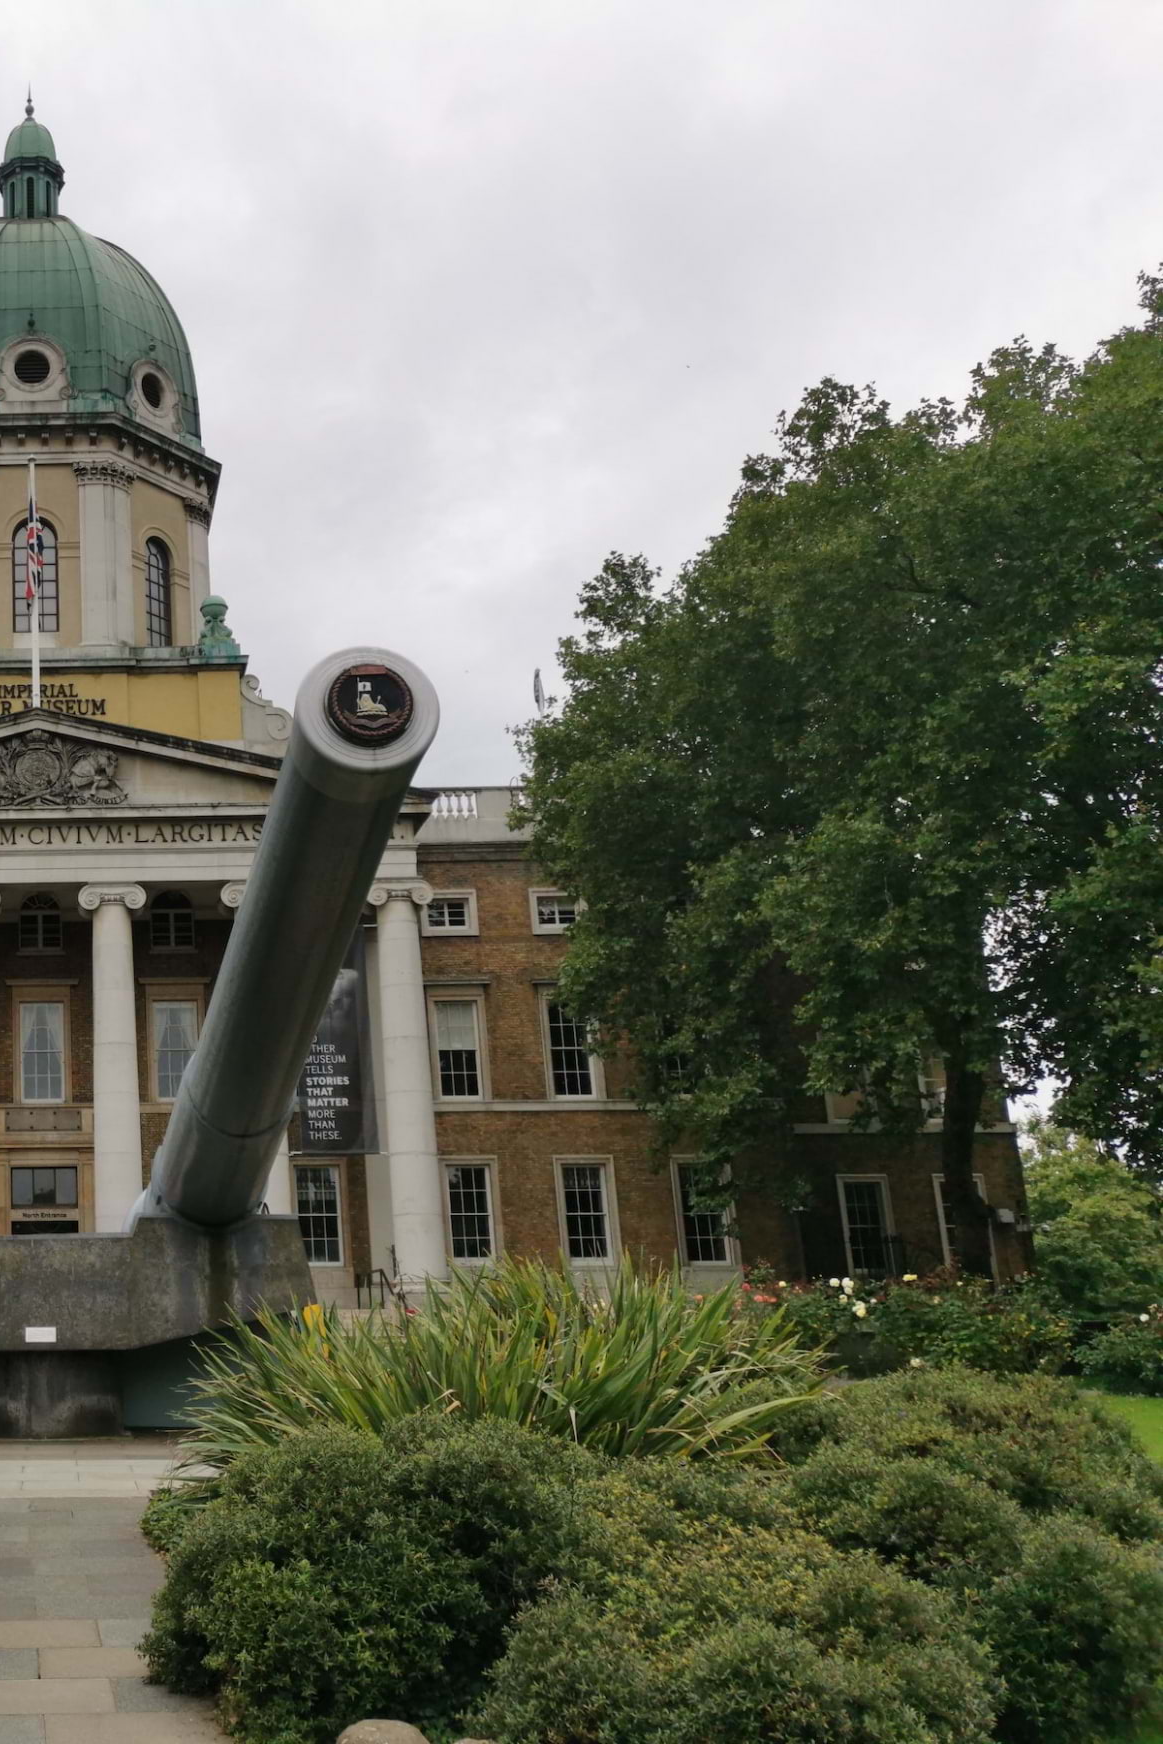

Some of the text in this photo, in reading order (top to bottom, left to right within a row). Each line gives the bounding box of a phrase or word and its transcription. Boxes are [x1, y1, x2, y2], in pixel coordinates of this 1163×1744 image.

[27, 824, 124, 845] CIVIVM
[311, 1044, 336, 1053] THER
[305, 1065, 333, 1074] TELLS
[306, 1076, 350, 1086] STORIES
[306, 1087, 333, 1096] THAT
[307, 1097, 348, 1107] MATTER
[308, 1109, 336, 1119] MORE
[308, 1120, 336, 1129] THAN
